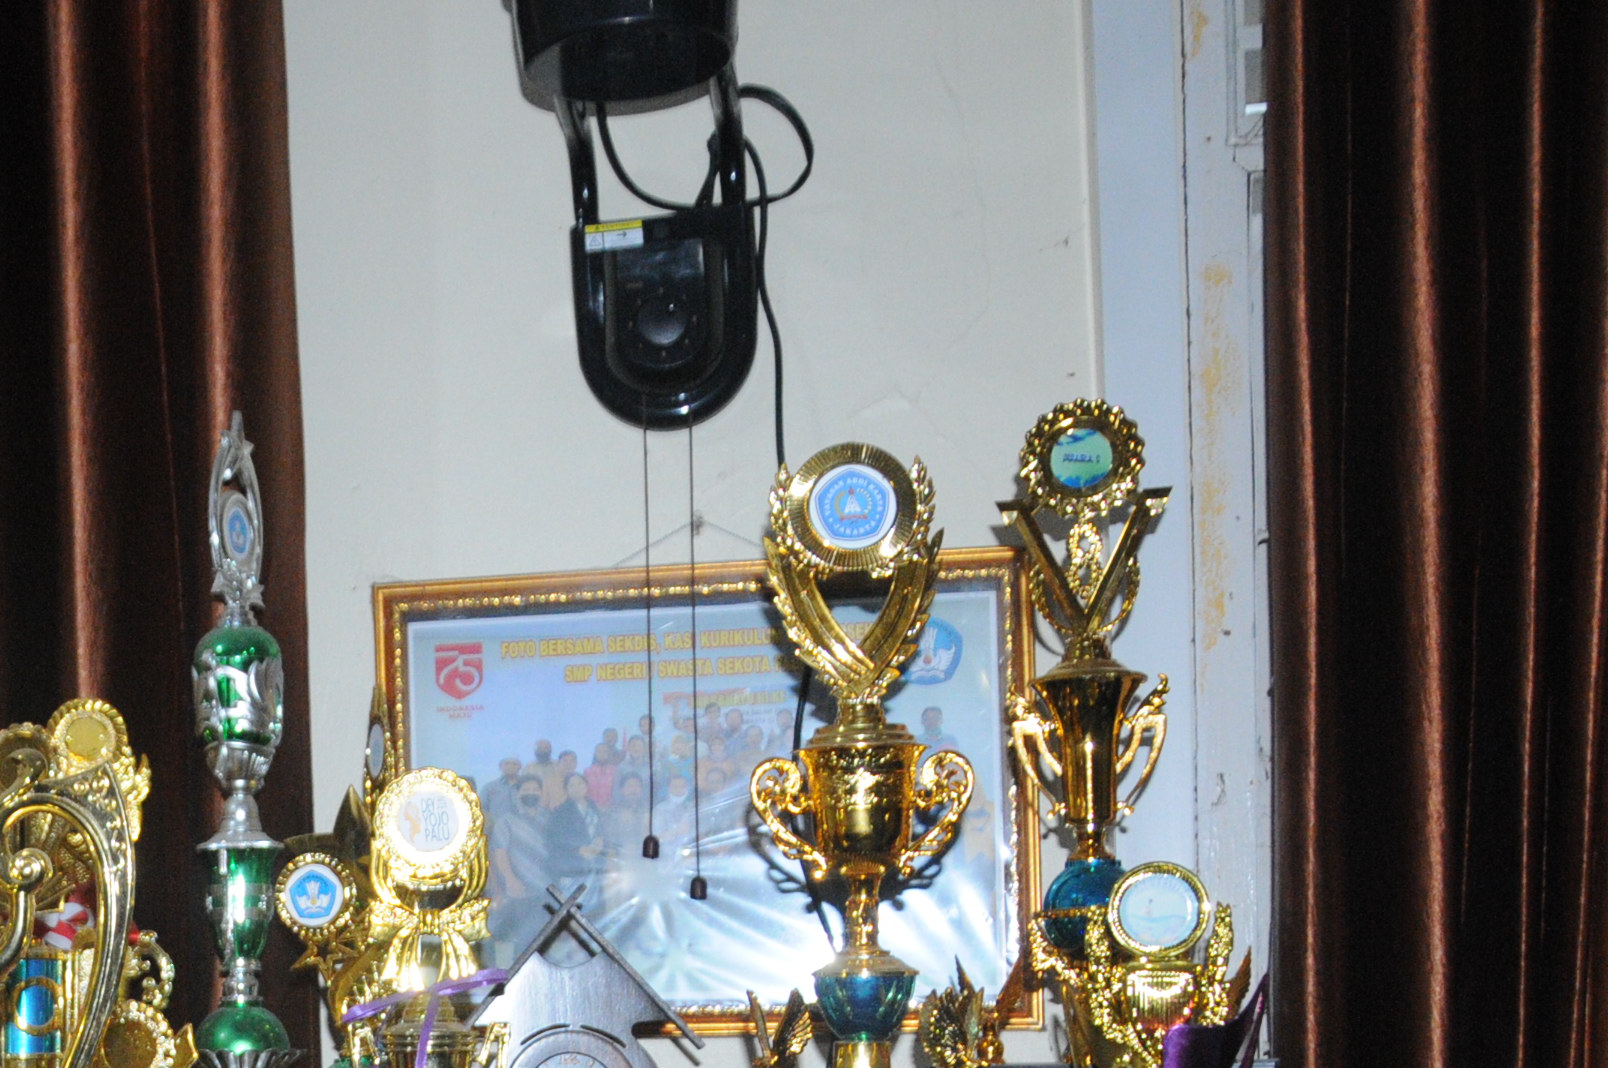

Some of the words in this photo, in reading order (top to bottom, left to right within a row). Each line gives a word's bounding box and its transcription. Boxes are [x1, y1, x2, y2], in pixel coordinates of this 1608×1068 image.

[501, 641, 535, 659] FOTO
[540, 637, 603, 657] BERSAMA
[565, 665, 592, 683] SMP
[596, 662, 648, 681] NEGERI
[658, 658, 713, 678] SWASTA
[717, 655, 769, 675] SEKOTA
[422, 810, 449, 827] YOJO
[425, 826, 450, 842] PALU
